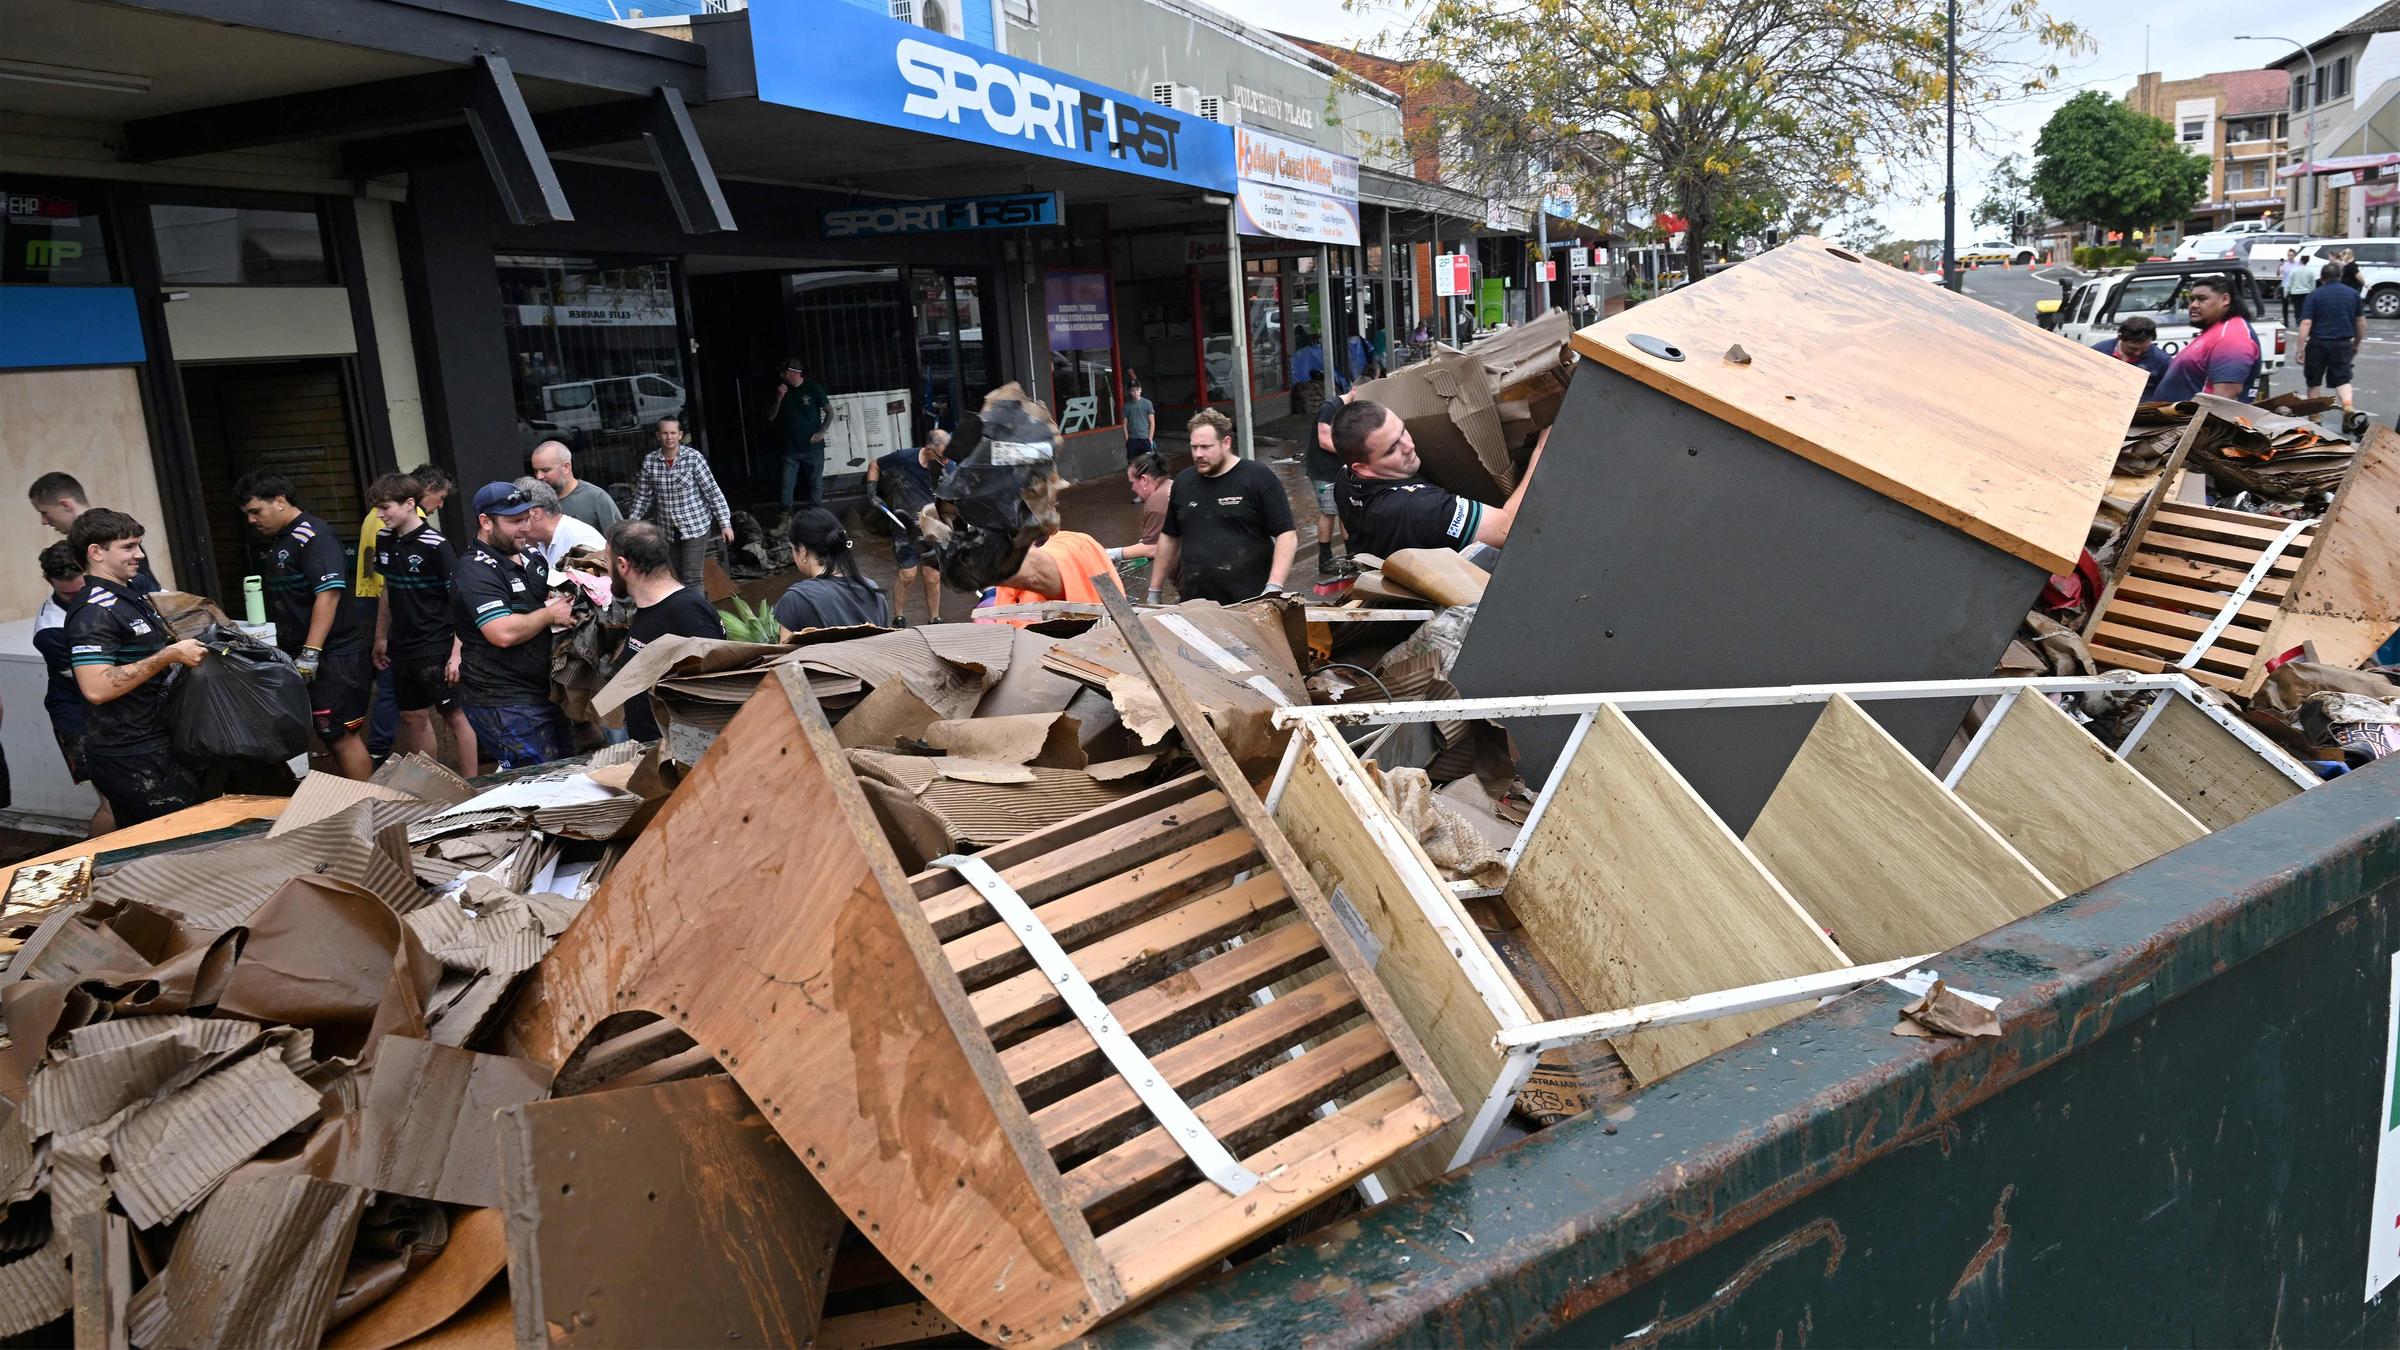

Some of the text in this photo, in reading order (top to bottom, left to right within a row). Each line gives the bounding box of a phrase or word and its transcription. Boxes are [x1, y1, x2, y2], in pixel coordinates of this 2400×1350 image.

[1233, 84, 1313, 129] PULTENEY PLACE
[1279, 148, 1304, 182] Coast
[1305, 154, 1333, 187] Office
[9, 197, 39, 214] EHP
[1439, 258, 1451, 267] 2P
[1527, 1077, 1578, 1088] USTRALIAN
